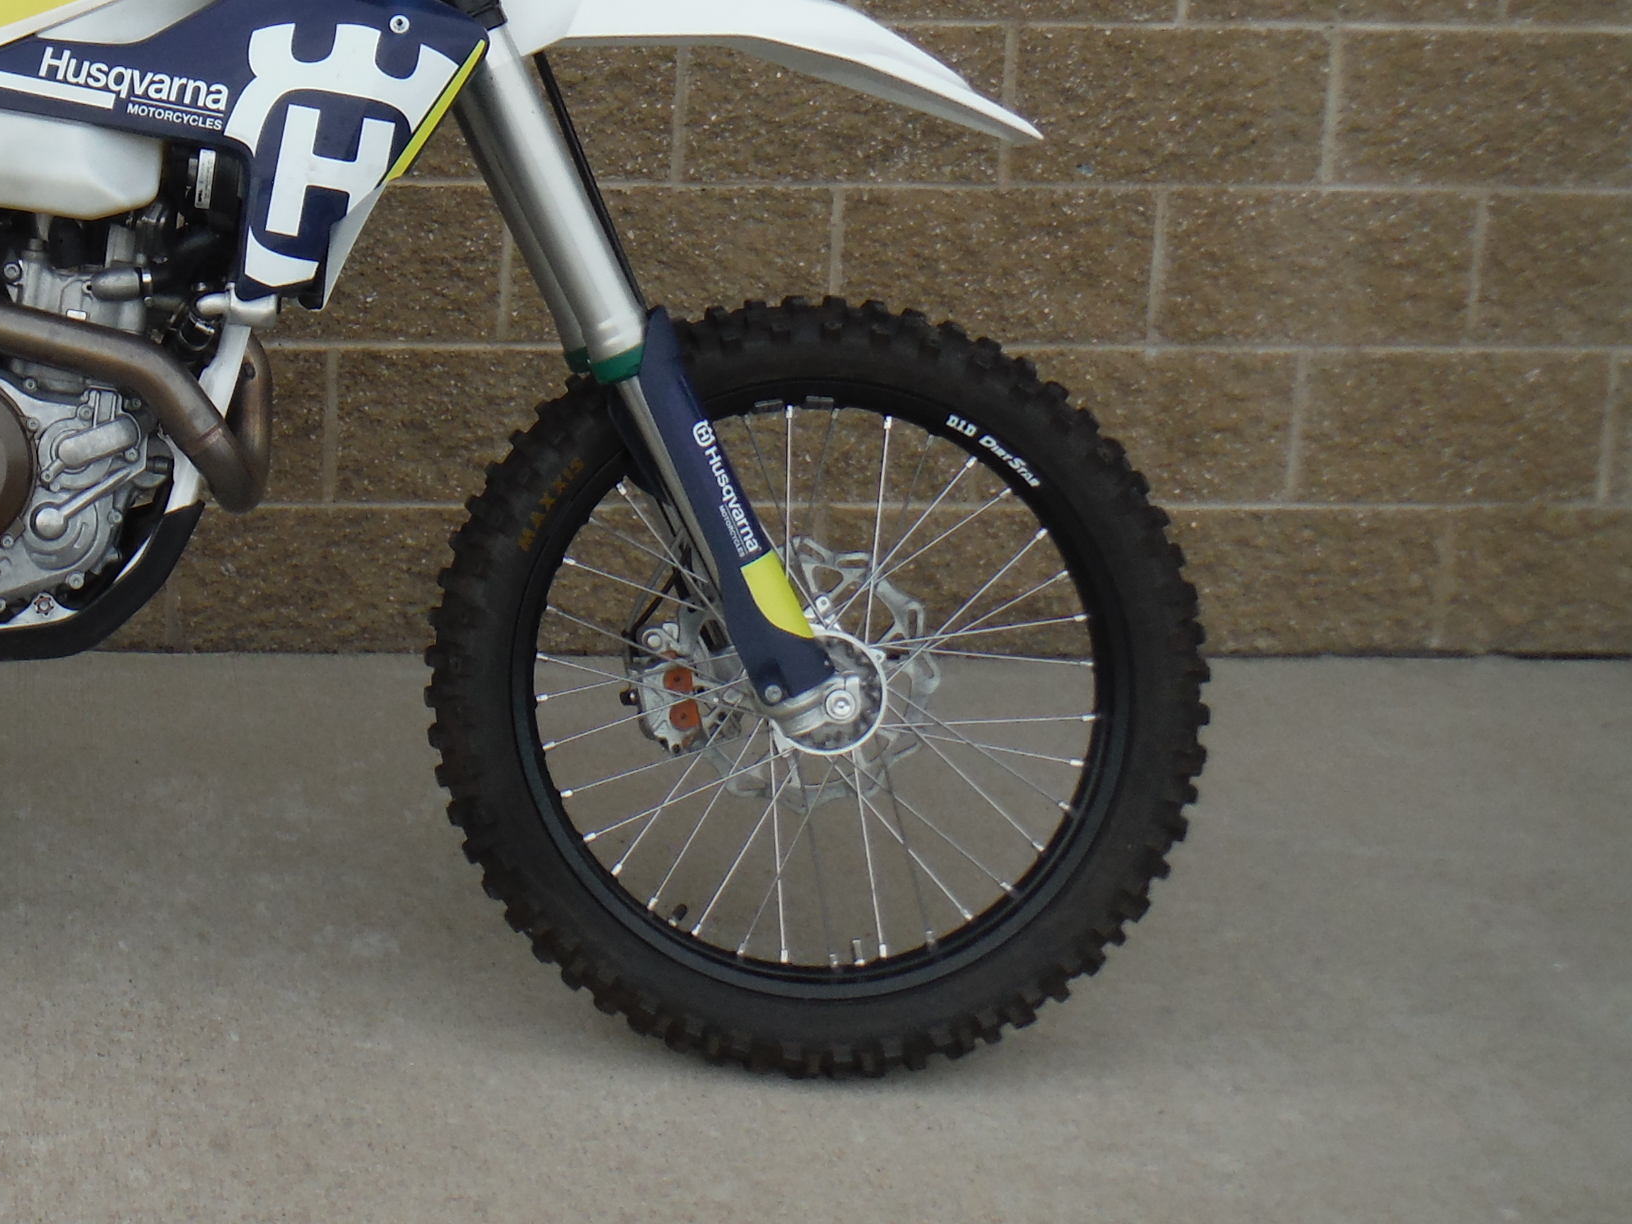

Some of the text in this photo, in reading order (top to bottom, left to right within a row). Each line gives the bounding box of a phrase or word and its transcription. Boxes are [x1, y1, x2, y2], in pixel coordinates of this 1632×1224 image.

[38, 46, 229, 111] Husqvarna
[126, 103, 223, 131] MOTORCYCLES
[704, 445, 759, 554] Husqvarna
[718, 504, 746, 558] MOTORCYCLES
